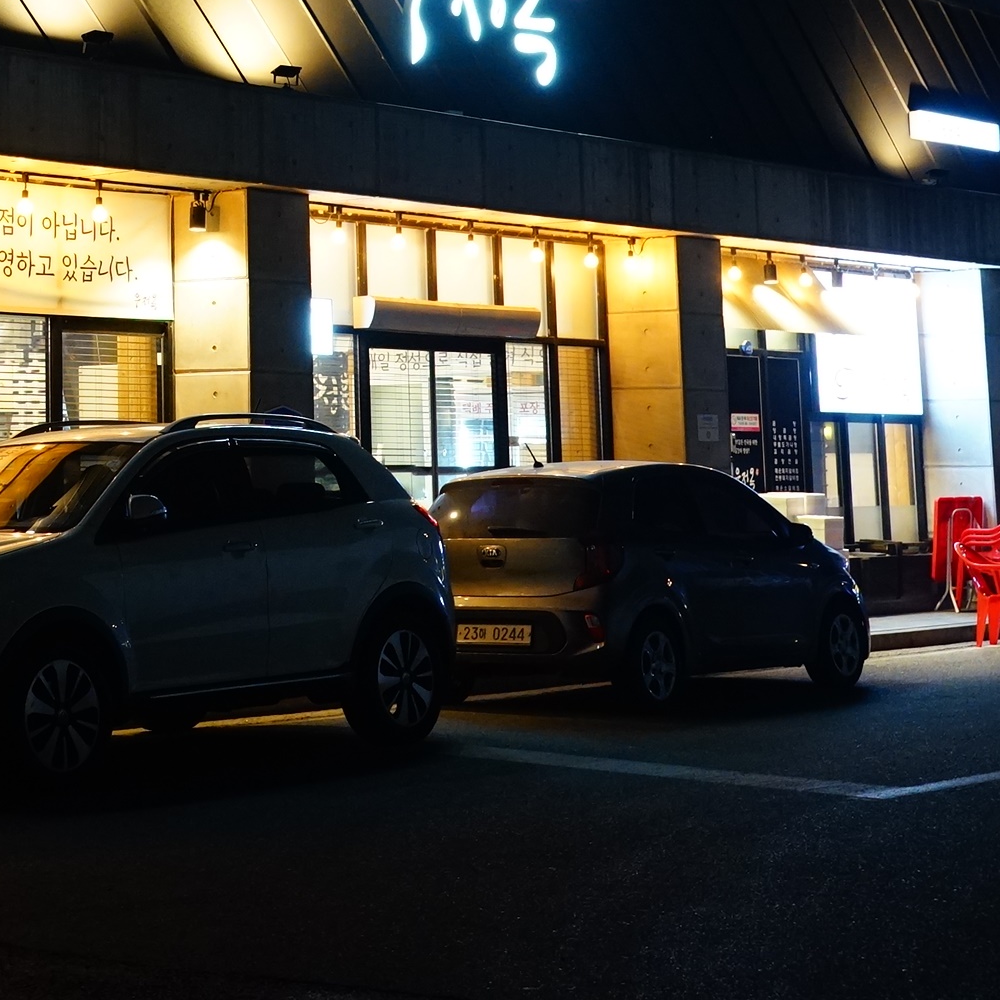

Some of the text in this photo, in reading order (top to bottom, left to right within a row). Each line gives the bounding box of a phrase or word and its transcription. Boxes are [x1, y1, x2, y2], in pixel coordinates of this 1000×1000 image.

[42, 211, 121, 242] 아닙니다.
[62, 252, 138, 283] 있습니다.
[519, 401, 540, 415] 포장
[493, 627, 525, 641] 0244
